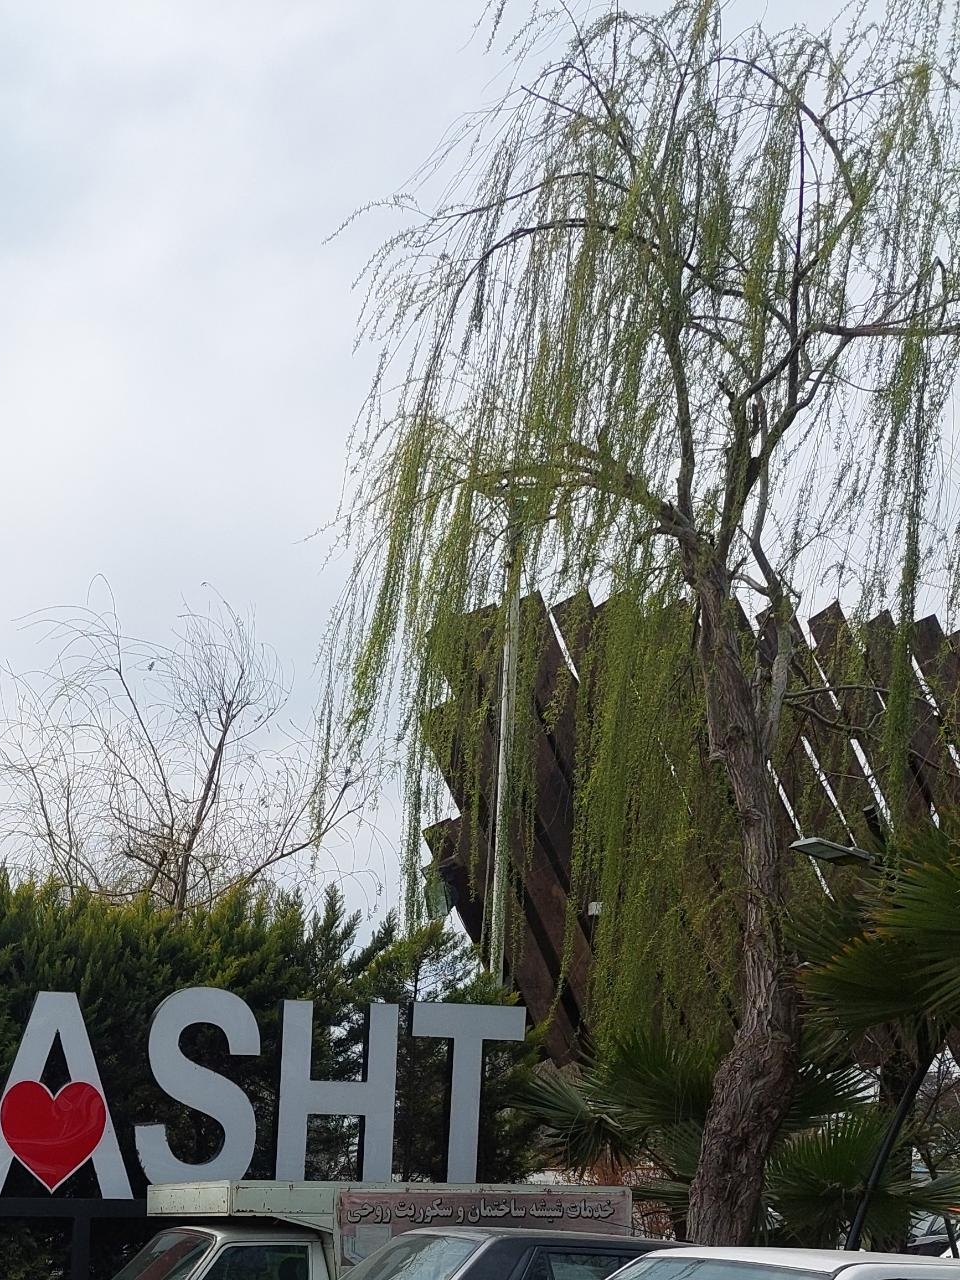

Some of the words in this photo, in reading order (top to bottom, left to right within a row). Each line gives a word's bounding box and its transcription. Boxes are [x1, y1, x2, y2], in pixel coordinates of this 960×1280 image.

[346, 1202, 392, 1224] روحی
[393, 1198, 453, 1224] سکوریت
[457, 1203, 466, 1224] و
[470, 1197, 527, 1225] ساختمان
[529, 1200, 565, 1224] شیشه
[567, 1201, 616, 1220] خدمات
